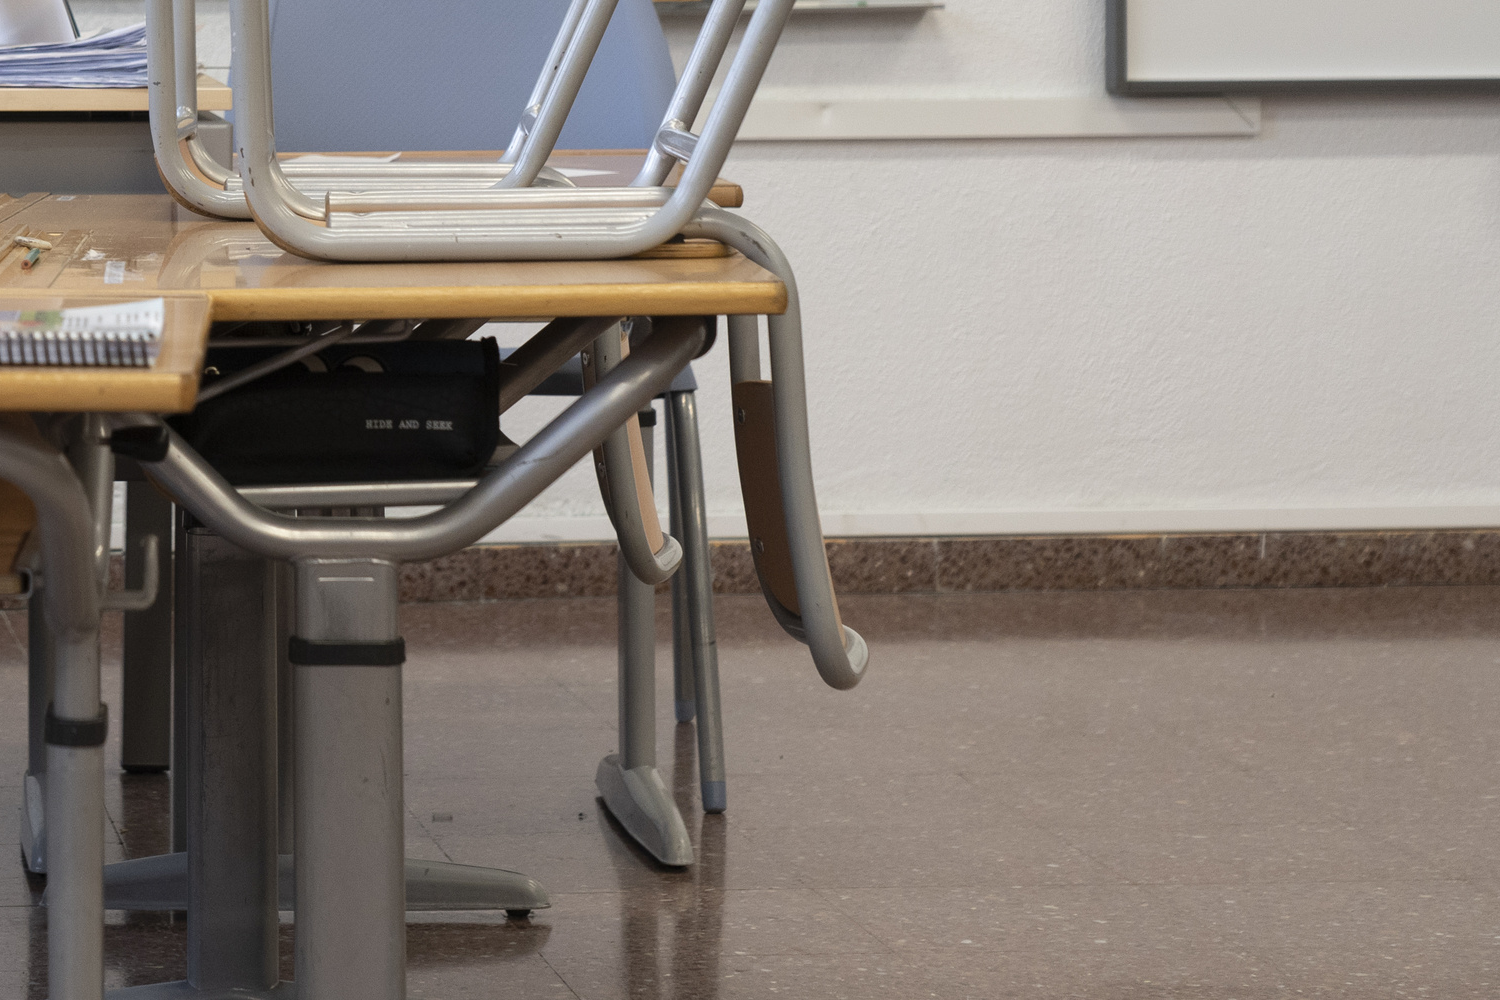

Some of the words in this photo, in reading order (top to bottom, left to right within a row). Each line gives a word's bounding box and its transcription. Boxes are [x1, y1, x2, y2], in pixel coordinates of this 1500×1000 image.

[365, 418, 394, 430] HIDE
[398, 418, 421, 430] AND
[425, 419, 454, 431] SEEK
